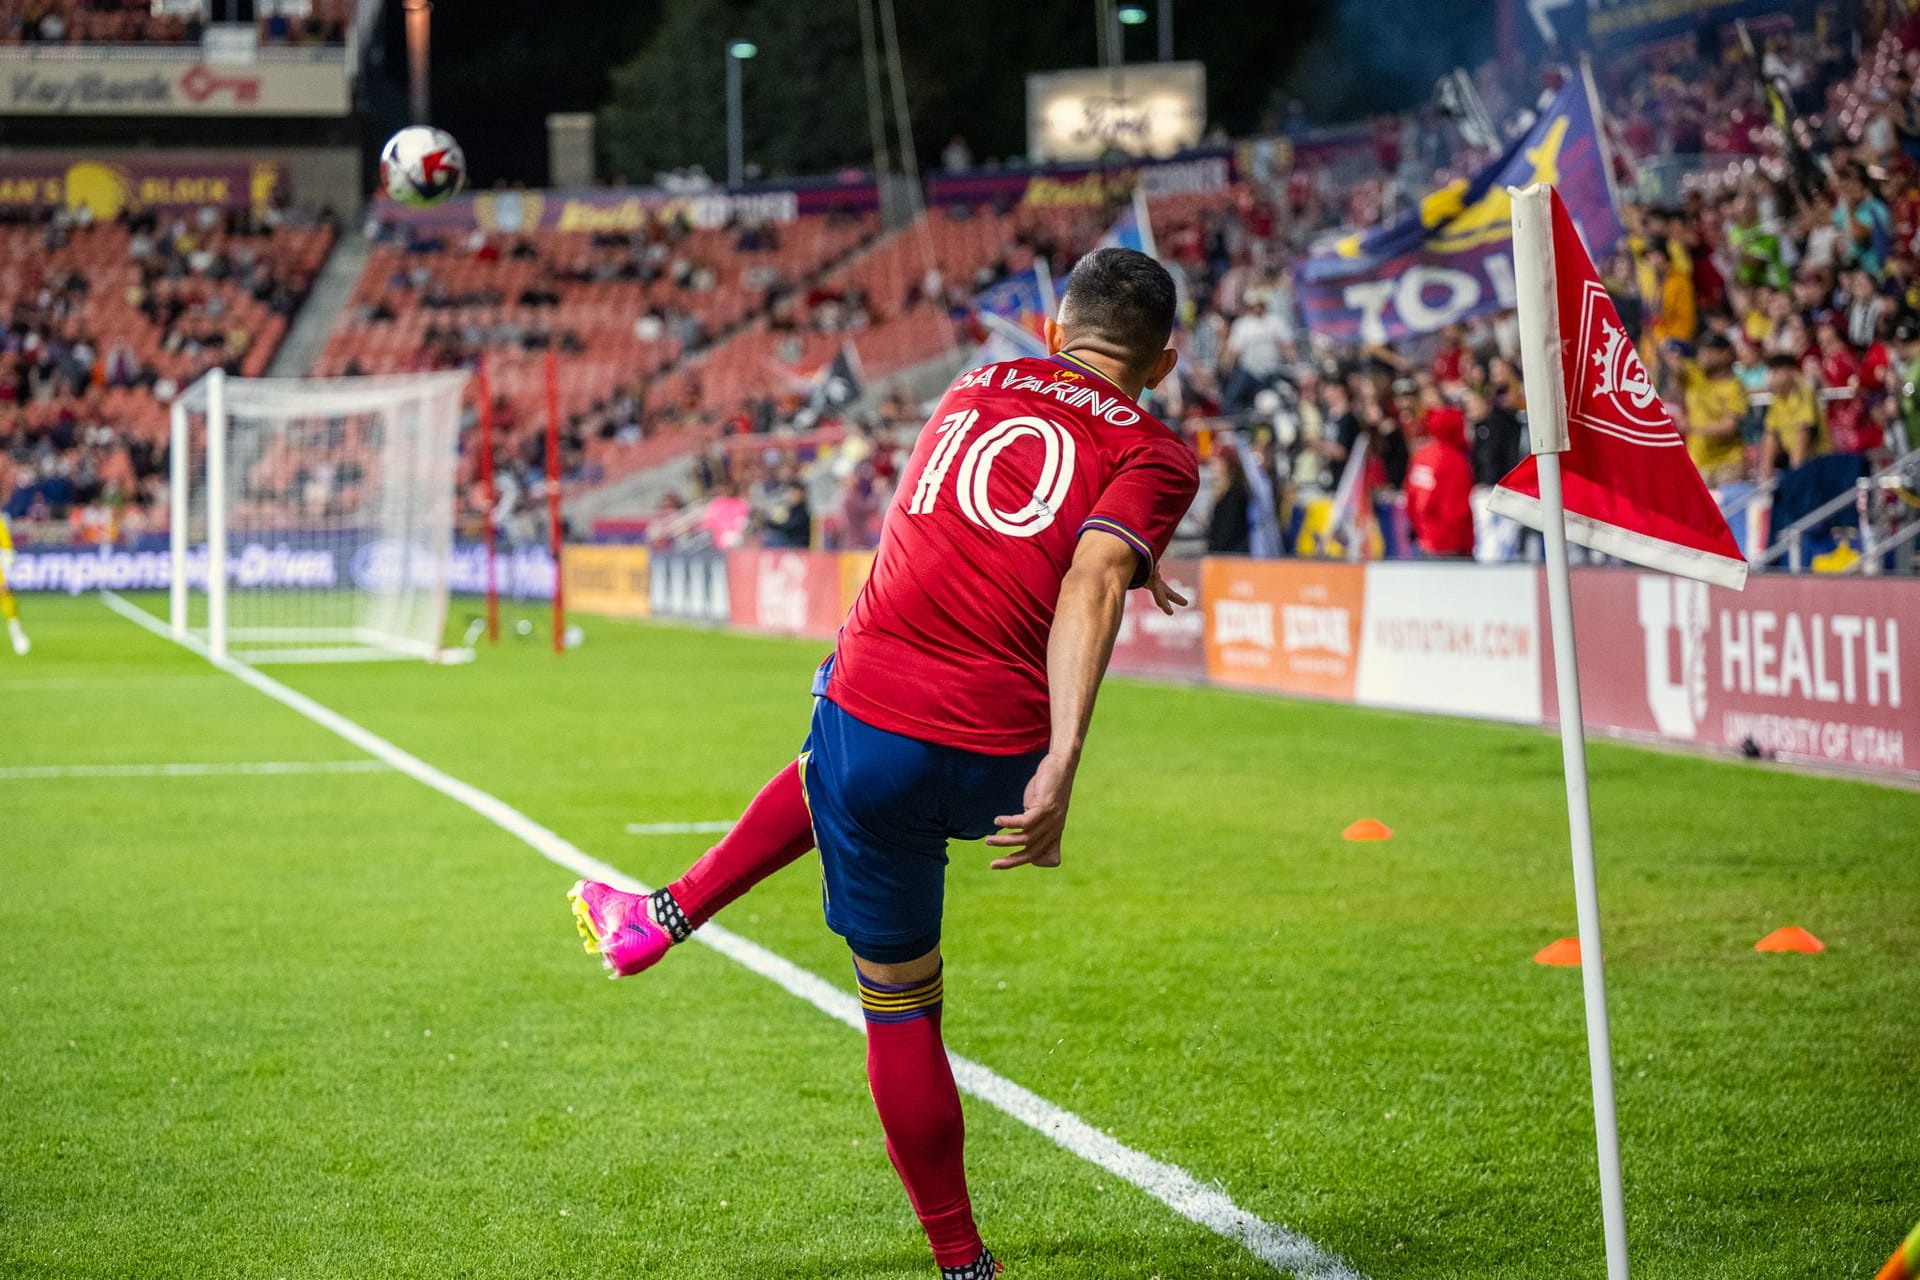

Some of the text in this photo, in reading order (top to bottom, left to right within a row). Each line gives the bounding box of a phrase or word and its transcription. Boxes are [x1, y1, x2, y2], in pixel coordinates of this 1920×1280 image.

[11, 73, 170, 113] KeyBank
[953, 364, 1141, 427] SAVARINO
[908, 408, 1076, 538] 10
[1719, 608, 1902, 709] HEALTH
[1723, 711, 1905, 768] UNIVERSITY OF UTAH
